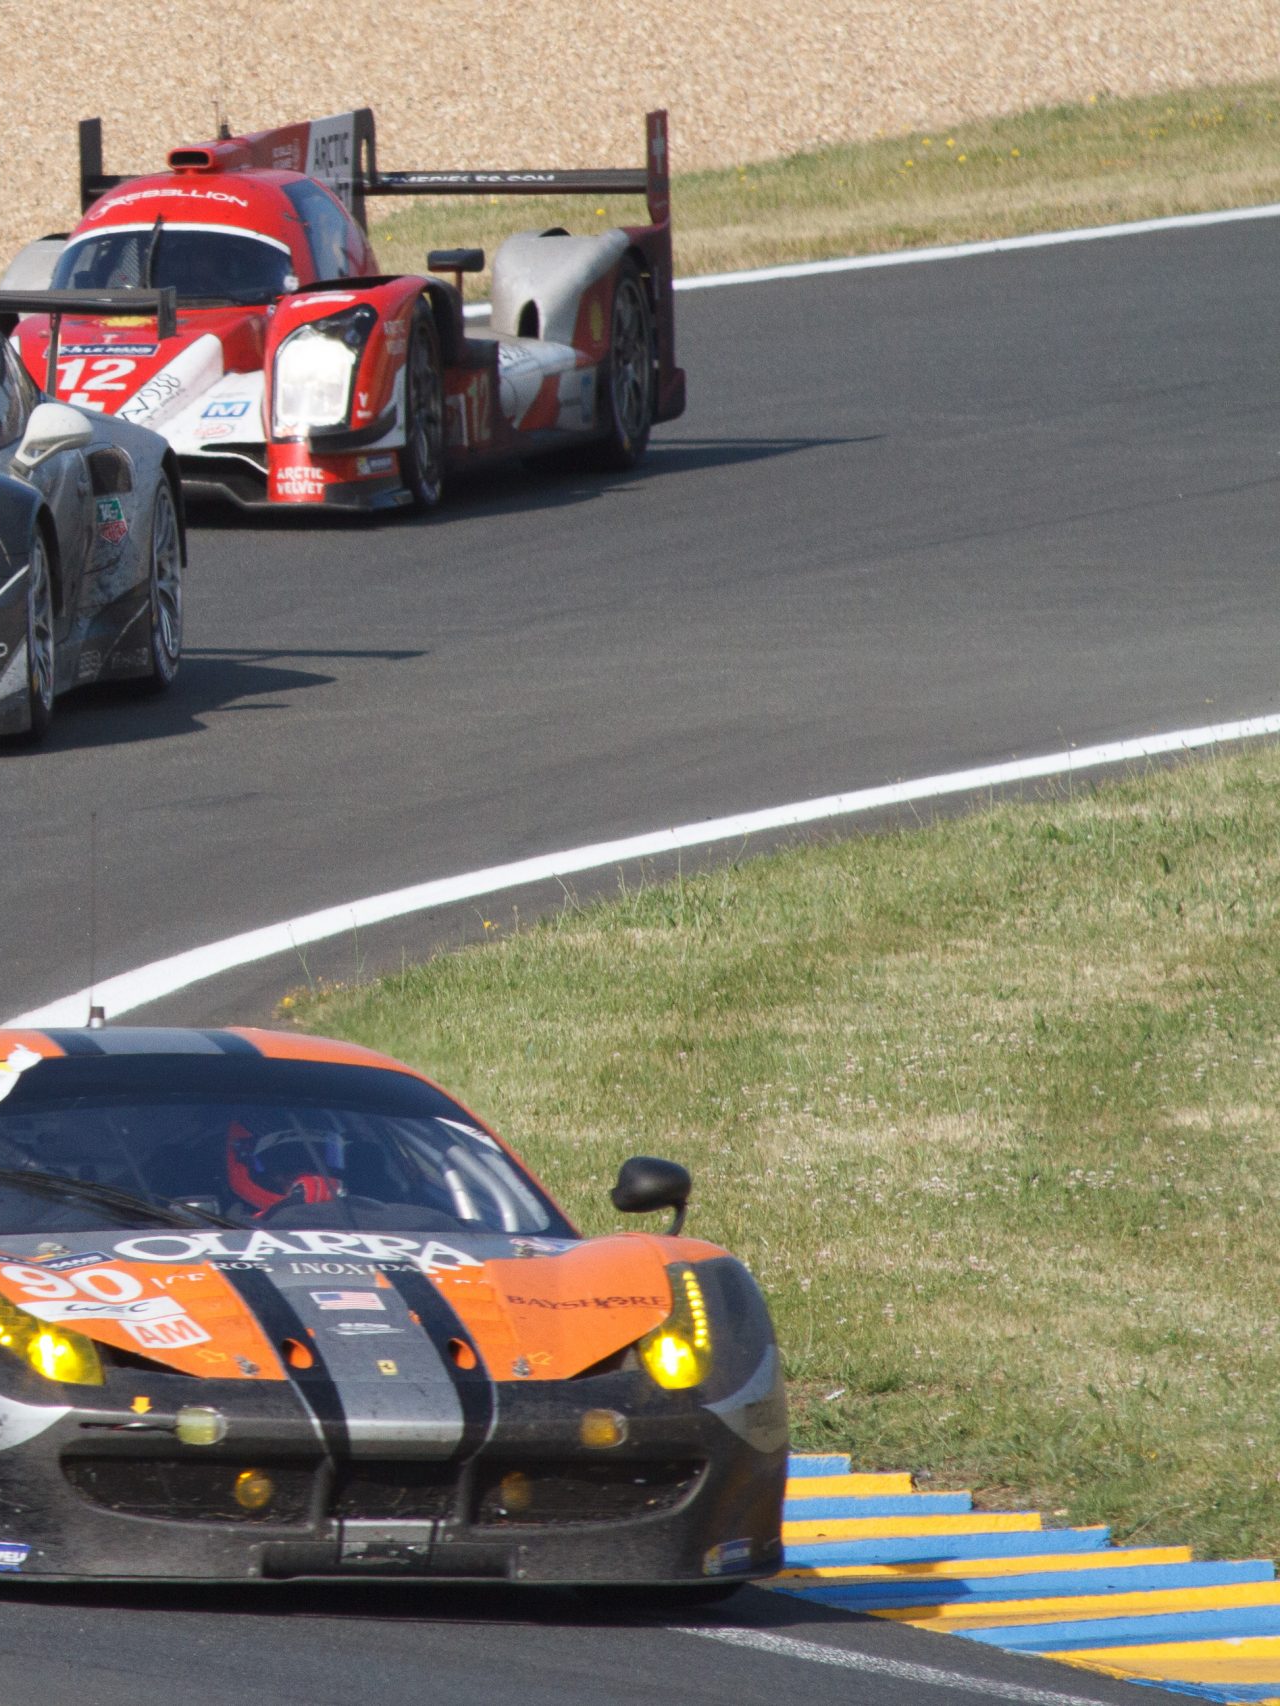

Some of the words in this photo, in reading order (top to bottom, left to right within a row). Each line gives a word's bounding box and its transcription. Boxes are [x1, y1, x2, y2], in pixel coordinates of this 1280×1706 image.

[96, 189, 248, 211] REBELLION
[56, 358, 137, 391] 12
[276, 466, 324, 481] ARCTIC
[276, 480, 324, 495] VELVET
[114, 1230, 486, 1274] OLARRA
[0, 1265, 143, 1304] 90
[134, 1320, 204, 1345] AM
